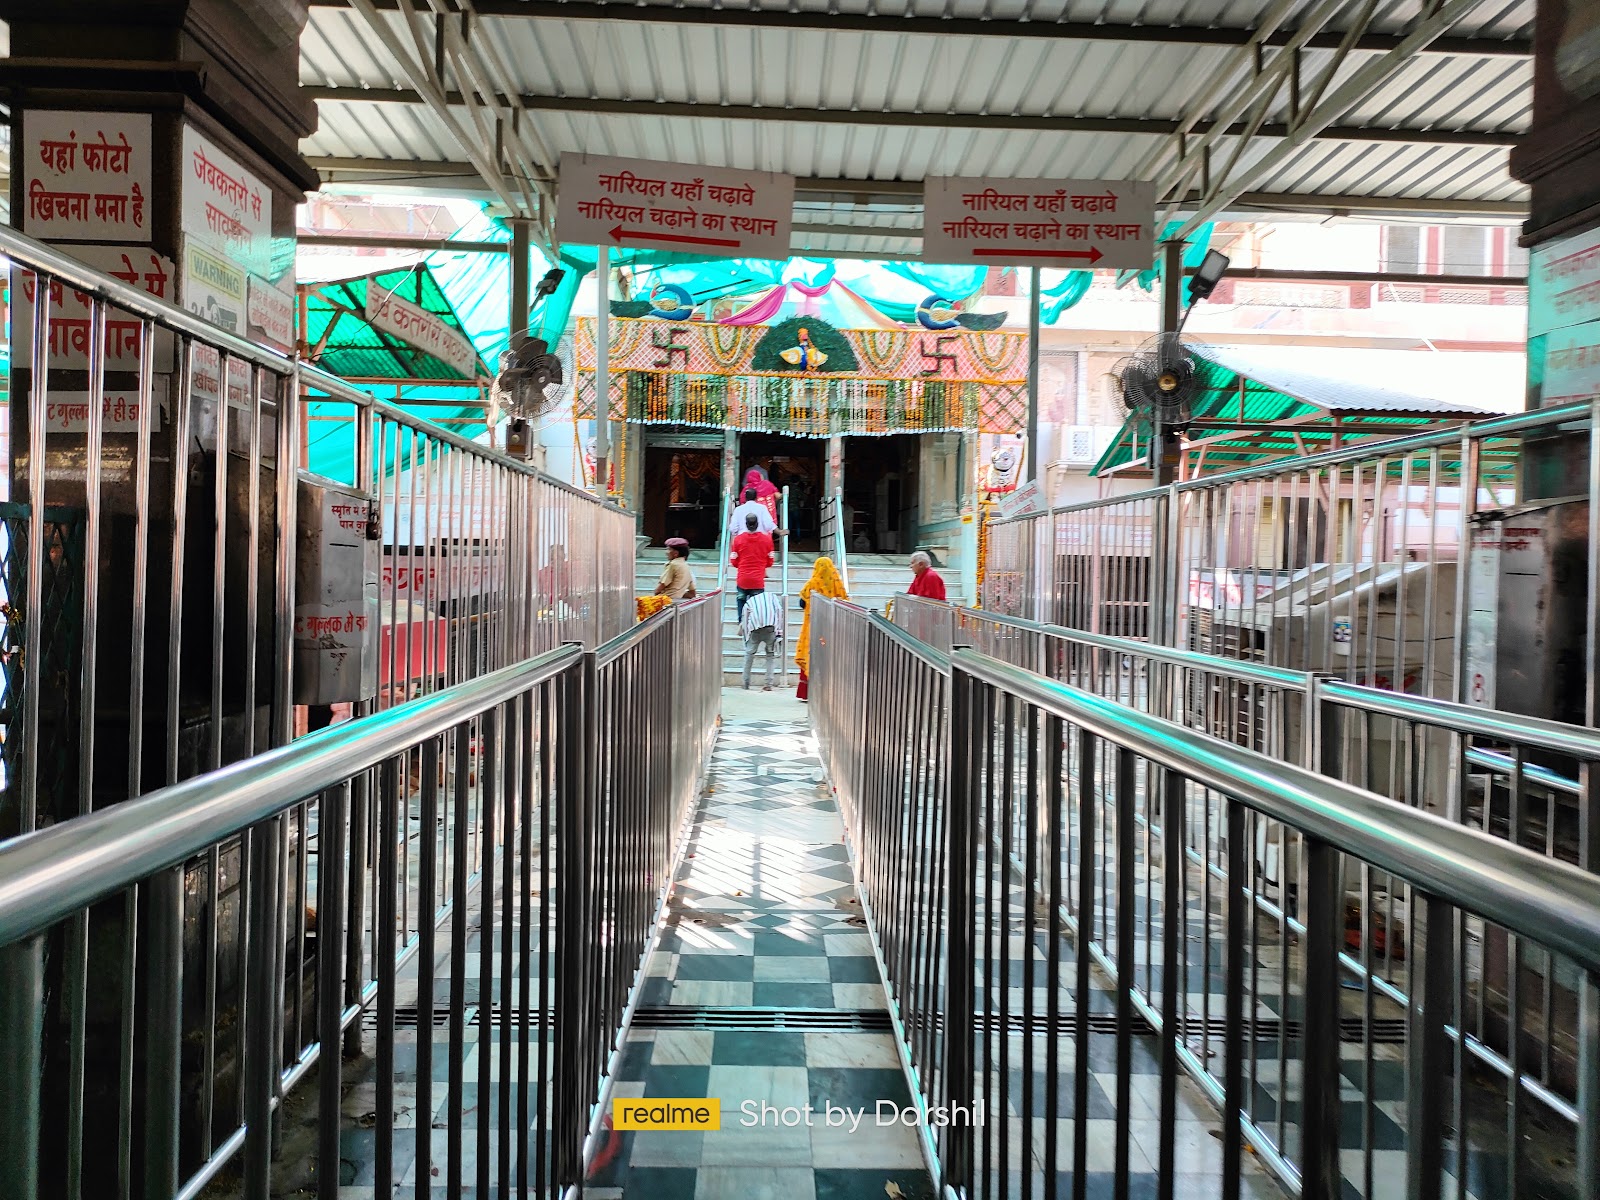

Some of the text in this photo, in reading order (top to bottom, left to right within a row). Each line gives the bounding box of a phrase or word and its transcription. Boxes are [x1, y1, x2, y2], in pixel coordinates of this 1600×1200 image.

[40, 130, 132, 174] यहां फोटो
[29, 179, 144, 228] खिचना मना है
[251, 187, 262, 222] से
[599, 170, 755, 207] नारियल यहाँ चढ़ावे
[962, 188, 1118, 215] नारियल यहाँ चढ़ावे
[577, 197, 778, 236] नारियल चढ़ाने का स्थान
[942, 216, 1141, 242] नारियल चढ़ाने का स्थान
[193, 255, 240, 295] WARNING
